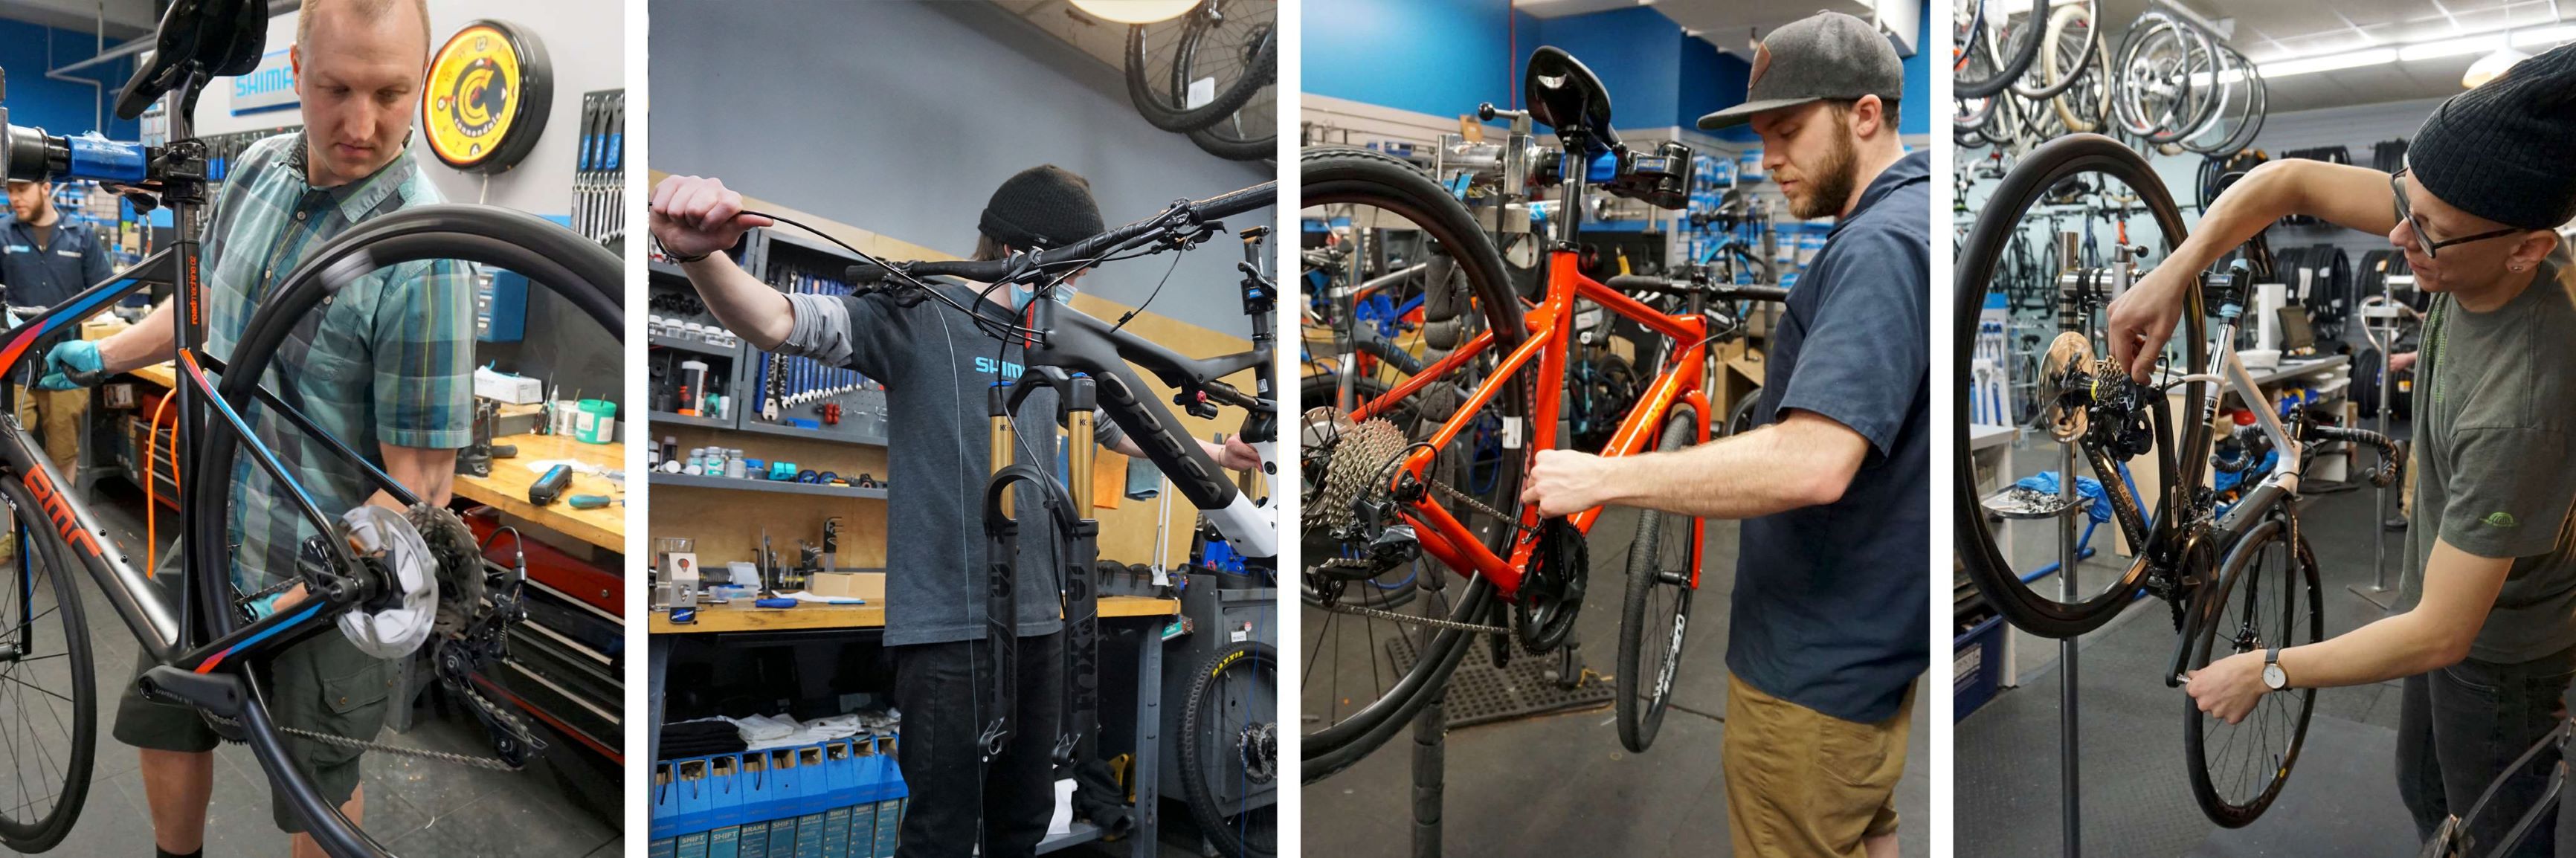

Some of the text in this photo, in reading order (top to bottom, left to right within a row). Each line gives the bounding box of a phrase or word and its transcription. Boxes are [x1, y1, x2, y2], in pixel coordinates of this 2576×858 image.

[190, 266, 199, 325] roadmachine
[975, 356, 1025, 378] SHIM
[1212, 651, 1244, 678] MAXXIS
[742, 824, 767, 833] BRAKE
[773, 820, 794, 828] SHIFT
[682, 834, 705, 845] SHIFT
[713, 830, 738, 841] SHIFT
